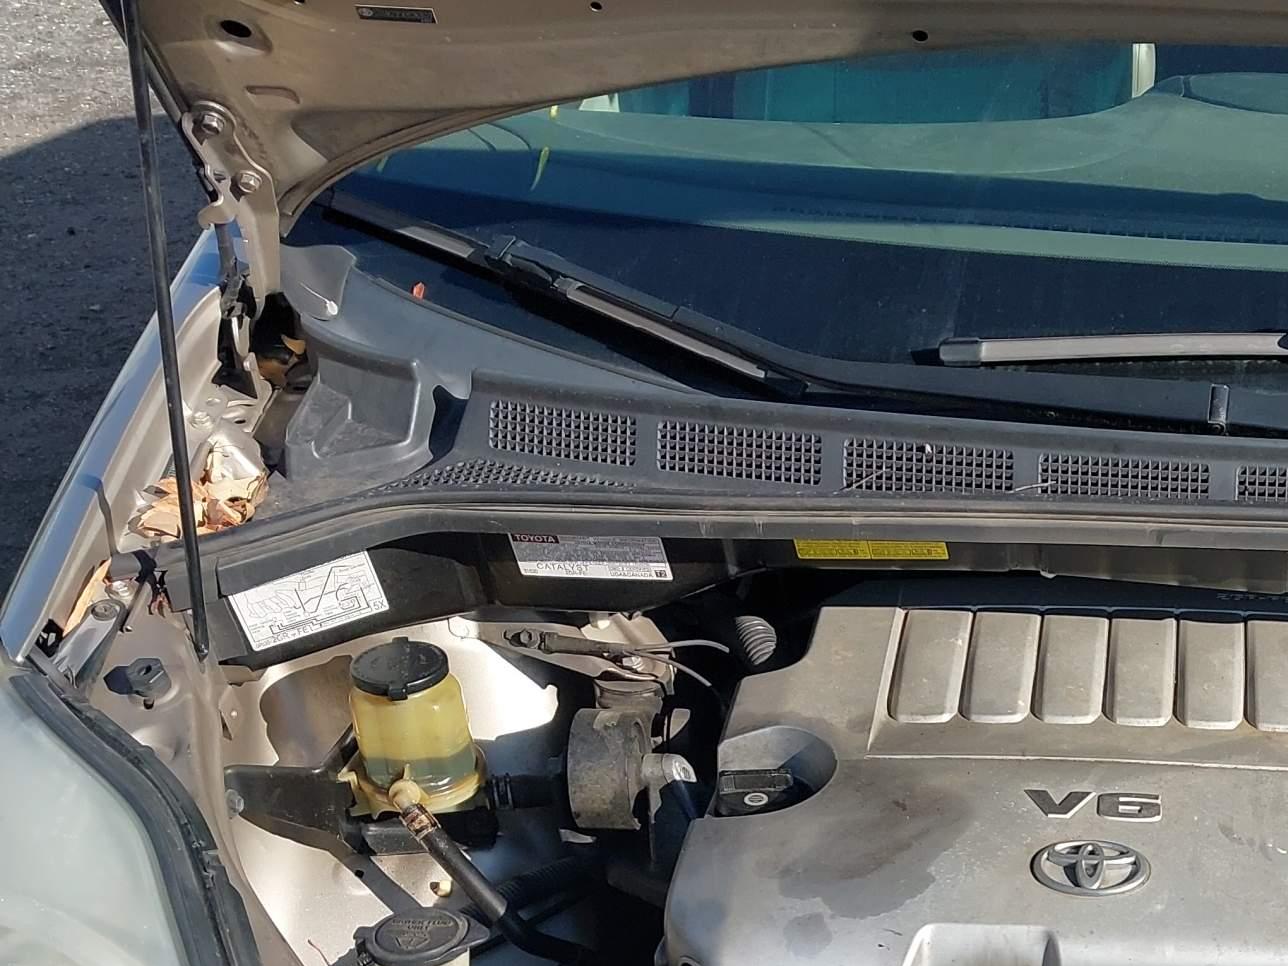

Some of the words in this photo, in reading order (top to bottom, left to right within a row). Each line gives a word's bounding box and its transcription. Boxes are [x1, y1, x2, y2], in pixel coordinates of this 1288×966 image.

[514, 534, 556, 543] TOYOTA
[536, 562, 590, 572] CATALYST
[373, 599, 388, 611] 5X
[1023, 788, 1163, 824] V6
